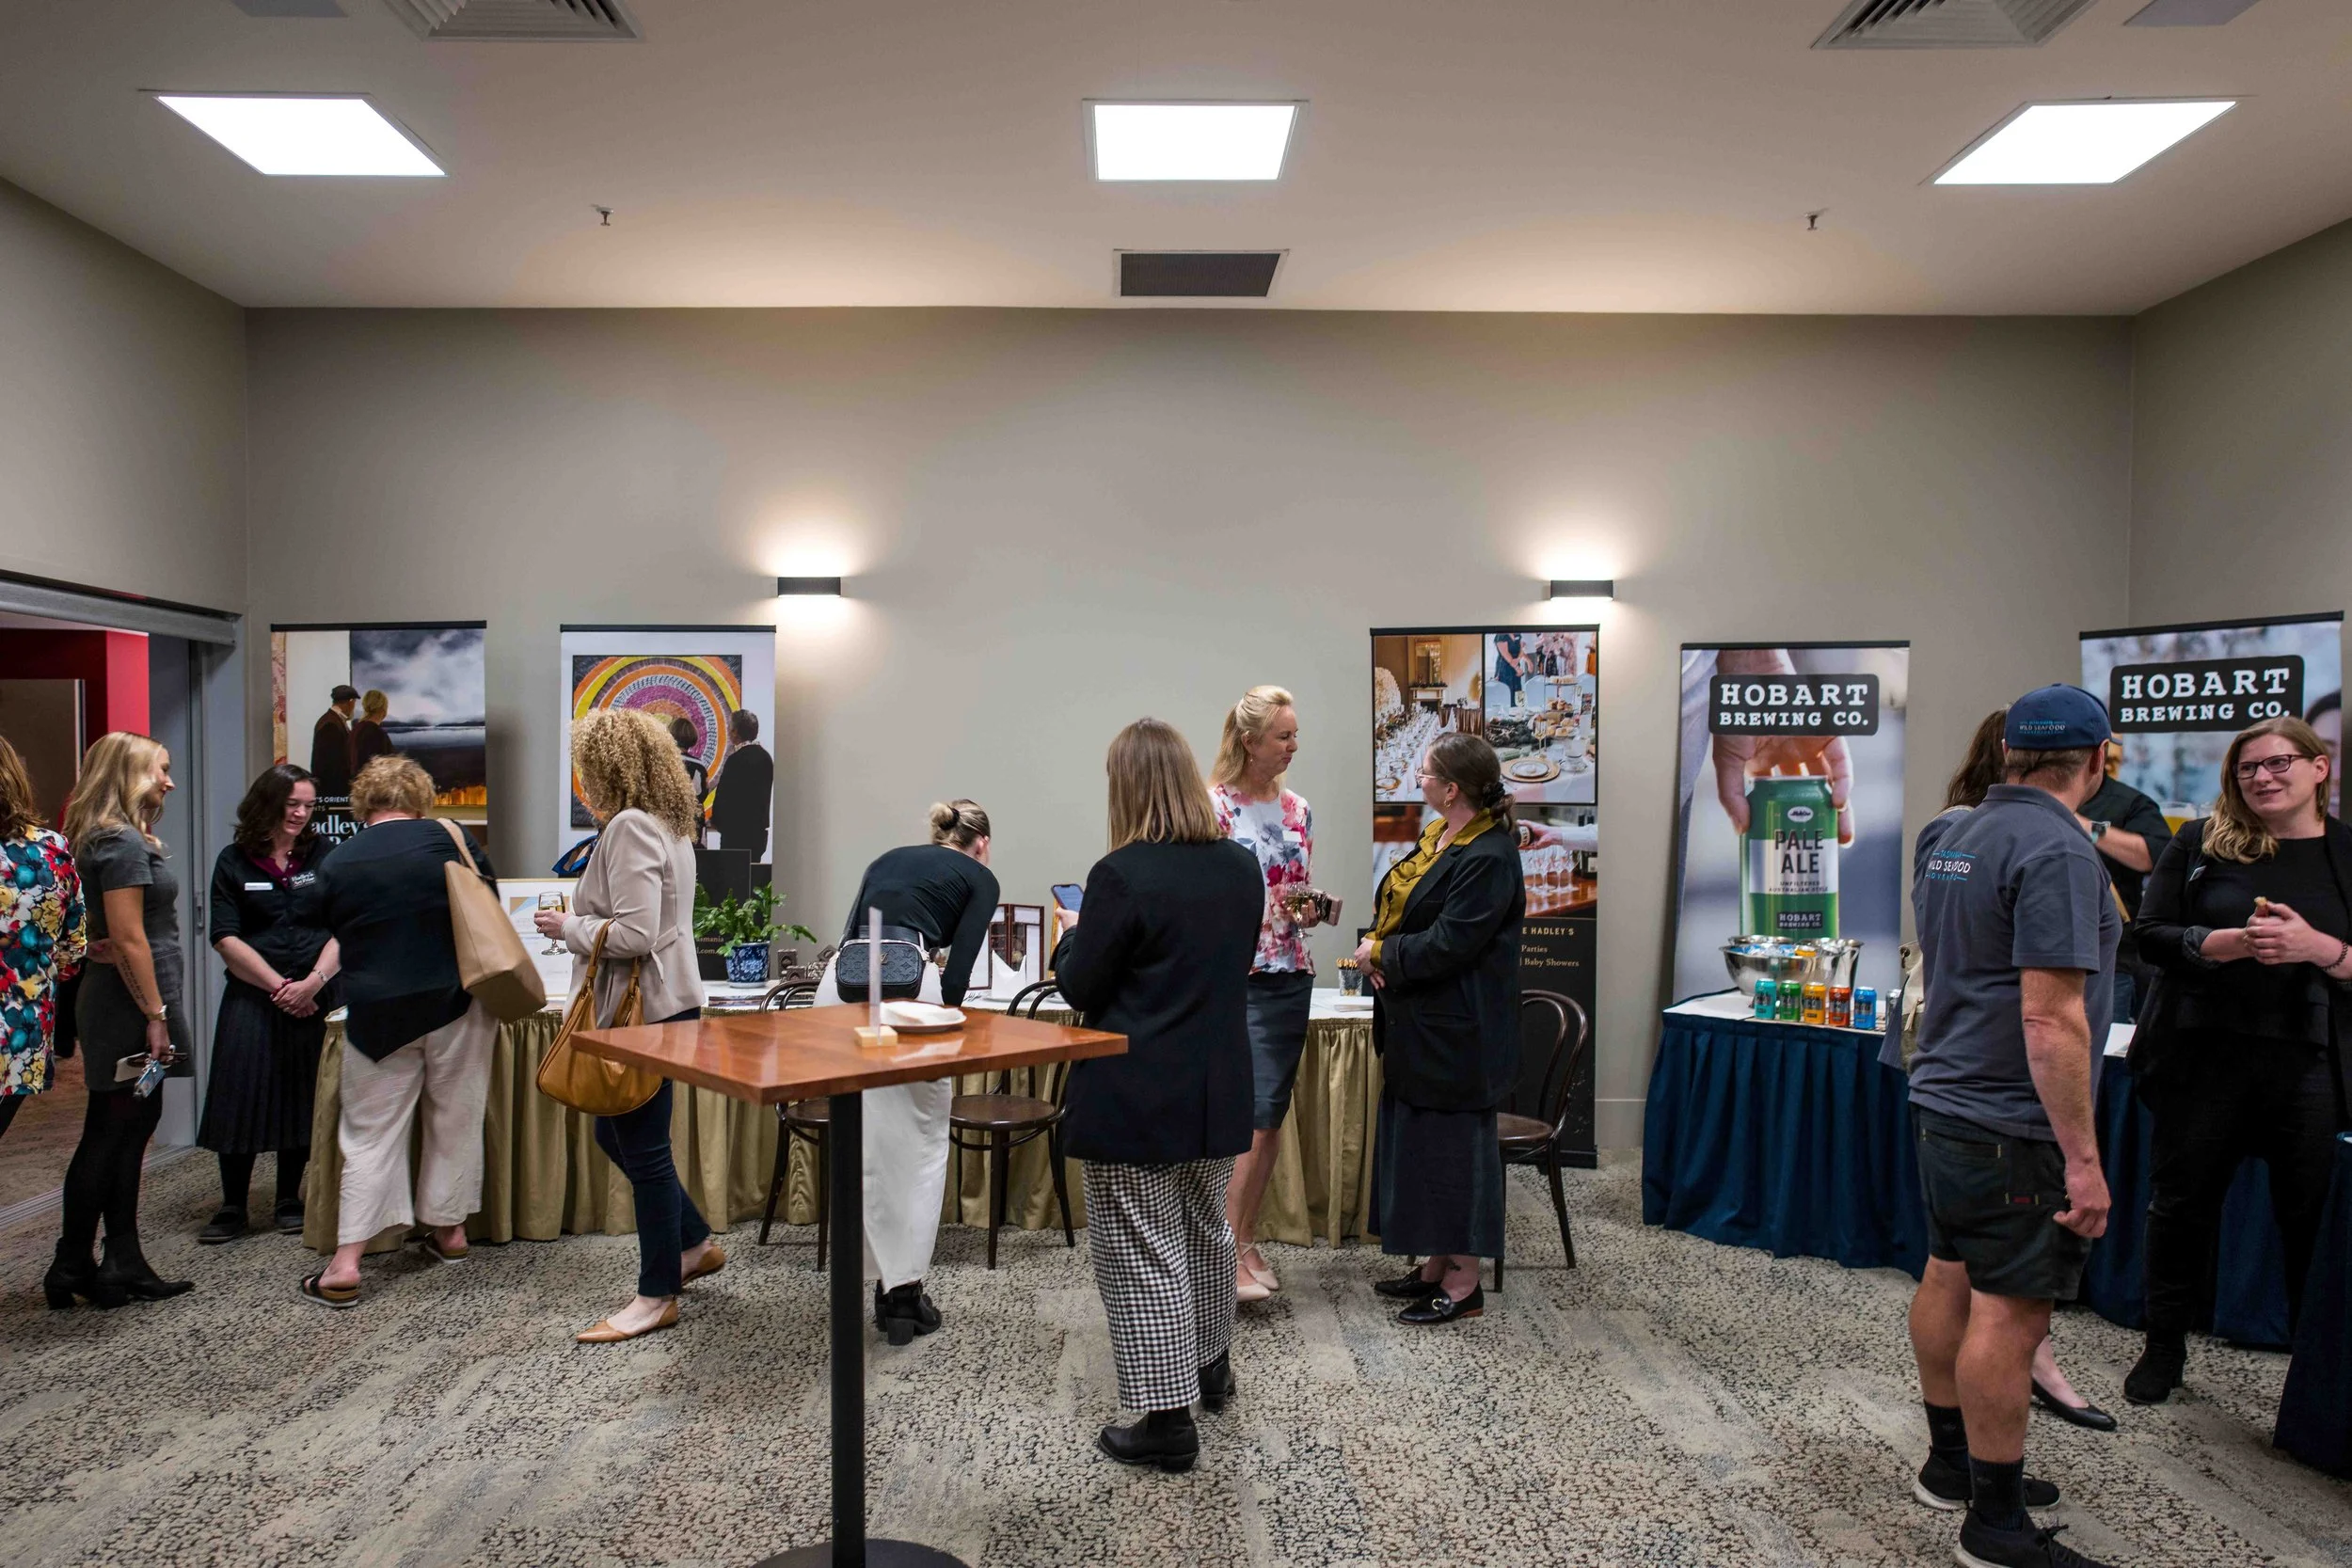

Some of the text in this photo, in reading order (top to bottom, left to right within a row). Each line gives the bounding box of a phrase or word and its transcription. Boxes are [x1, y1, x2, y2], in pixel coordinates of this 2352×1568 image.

[2121, 668, 2290, 700] HOBART
[1720, 684, 1868, 706] HOBART
[1719, 711, 1869, 726] BREWING CO.
[2120, 701, 2291, 722] BREWING CO.
[311, 815, 369, 834] adley
[1774, 829, 1824, 850] PALE
[1781, 853, 1820, 873] ALE
[1531, 927, 1574, 936] HADLEY'S
[1521, 944, 1549, 953] Parties
[1524, 958, 1580, 968] Baby Showers
